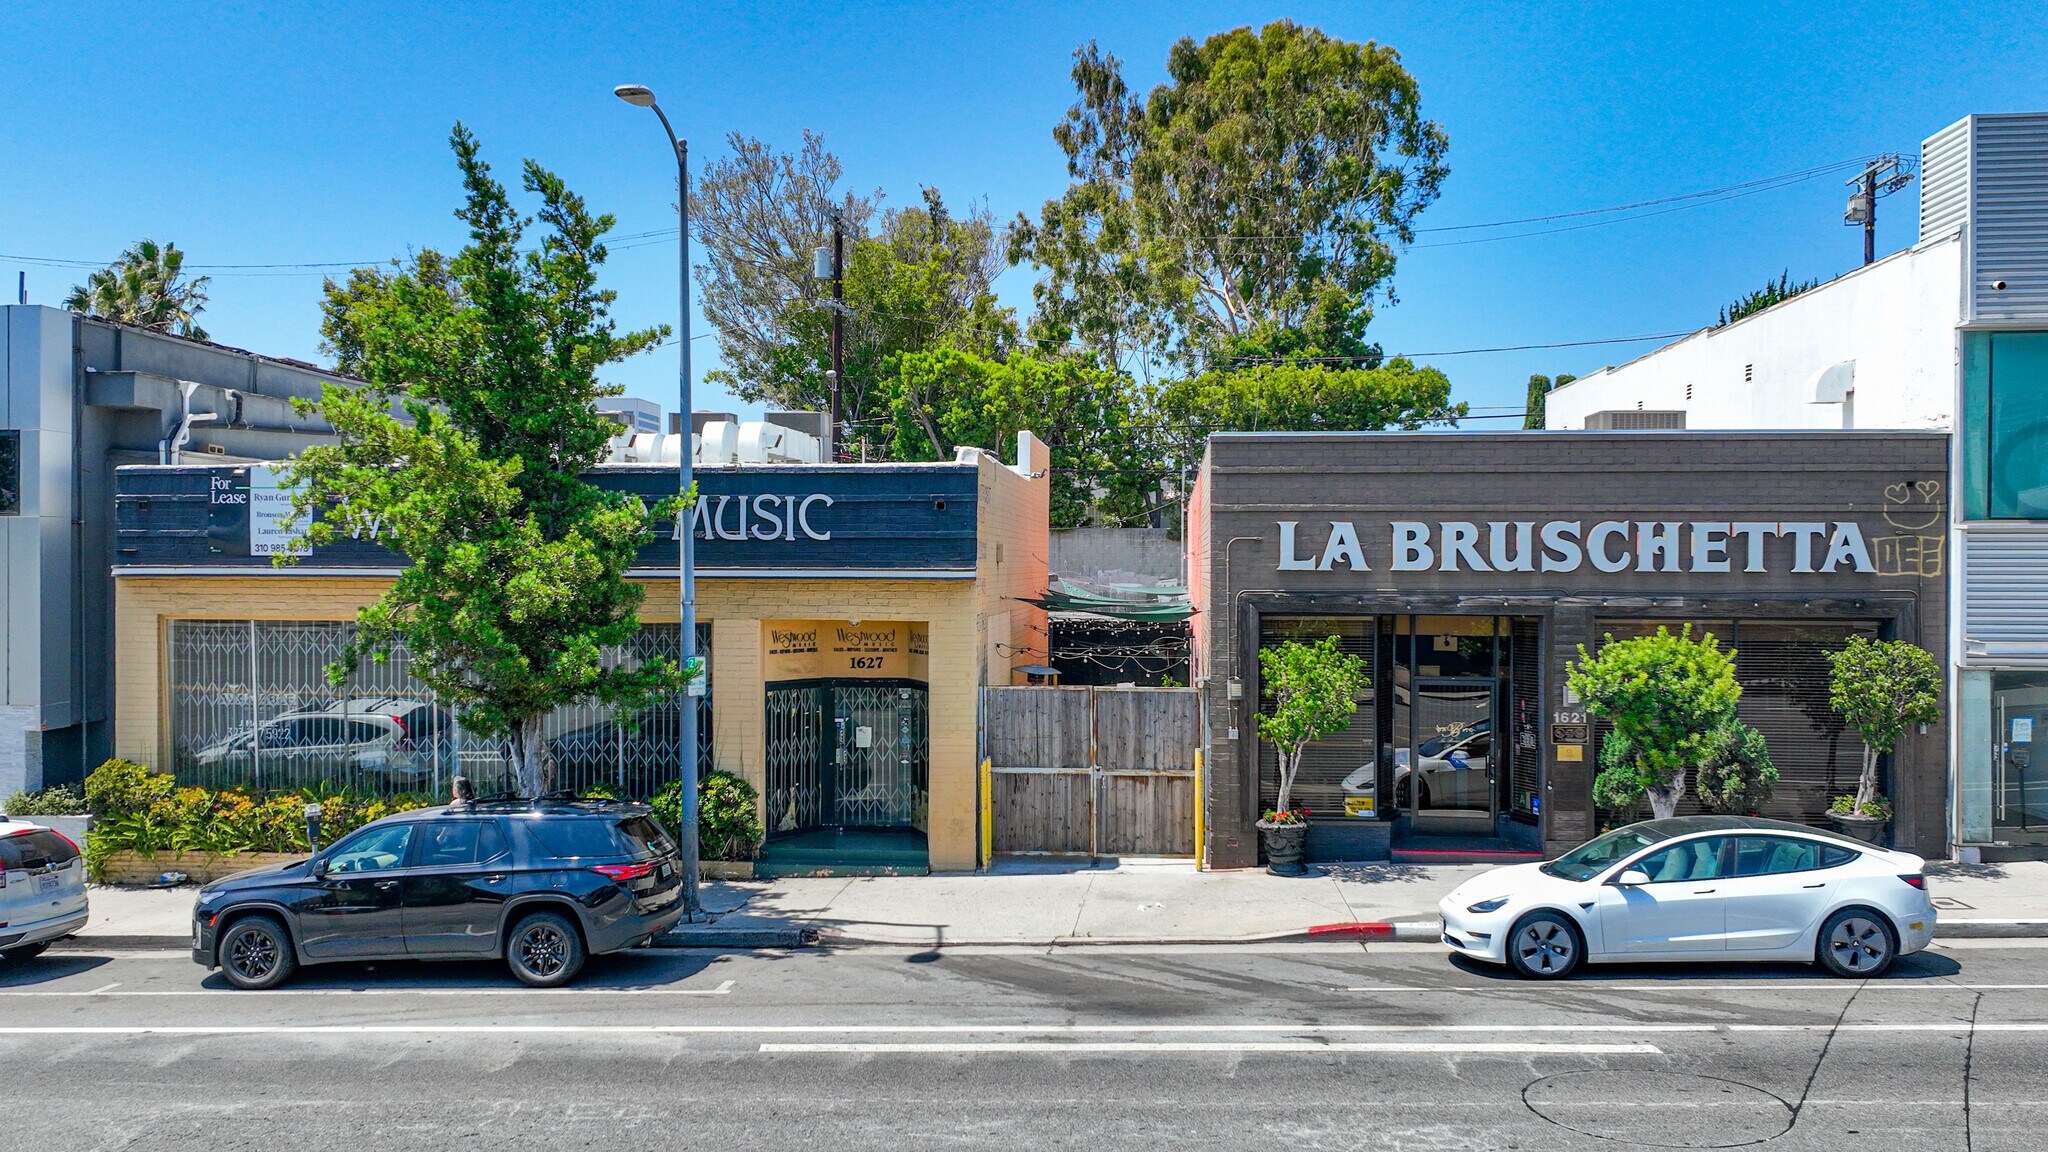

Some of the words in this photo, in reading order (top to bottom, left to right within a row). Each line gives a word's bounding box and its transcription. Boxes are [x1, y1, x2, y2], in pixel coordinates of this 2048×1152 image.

[211, 477, 231, 490] For
[211, 491, 247, 504] Lease
[254, 494, 274, 503] Ryan
[671, 493, 834, 541] MUSIC
[254, 544, 269, 552] 310
[1276, 521, 1372, 572] LA
[1389, 519, 1878, 574] BRUSCHETTA
[771, 629, 817, 648] Westwood
[836, 628, 896, 646] Westwood
[850, 656, 884, 669] 1627
[1553, 711, 1587, 723] 1621
